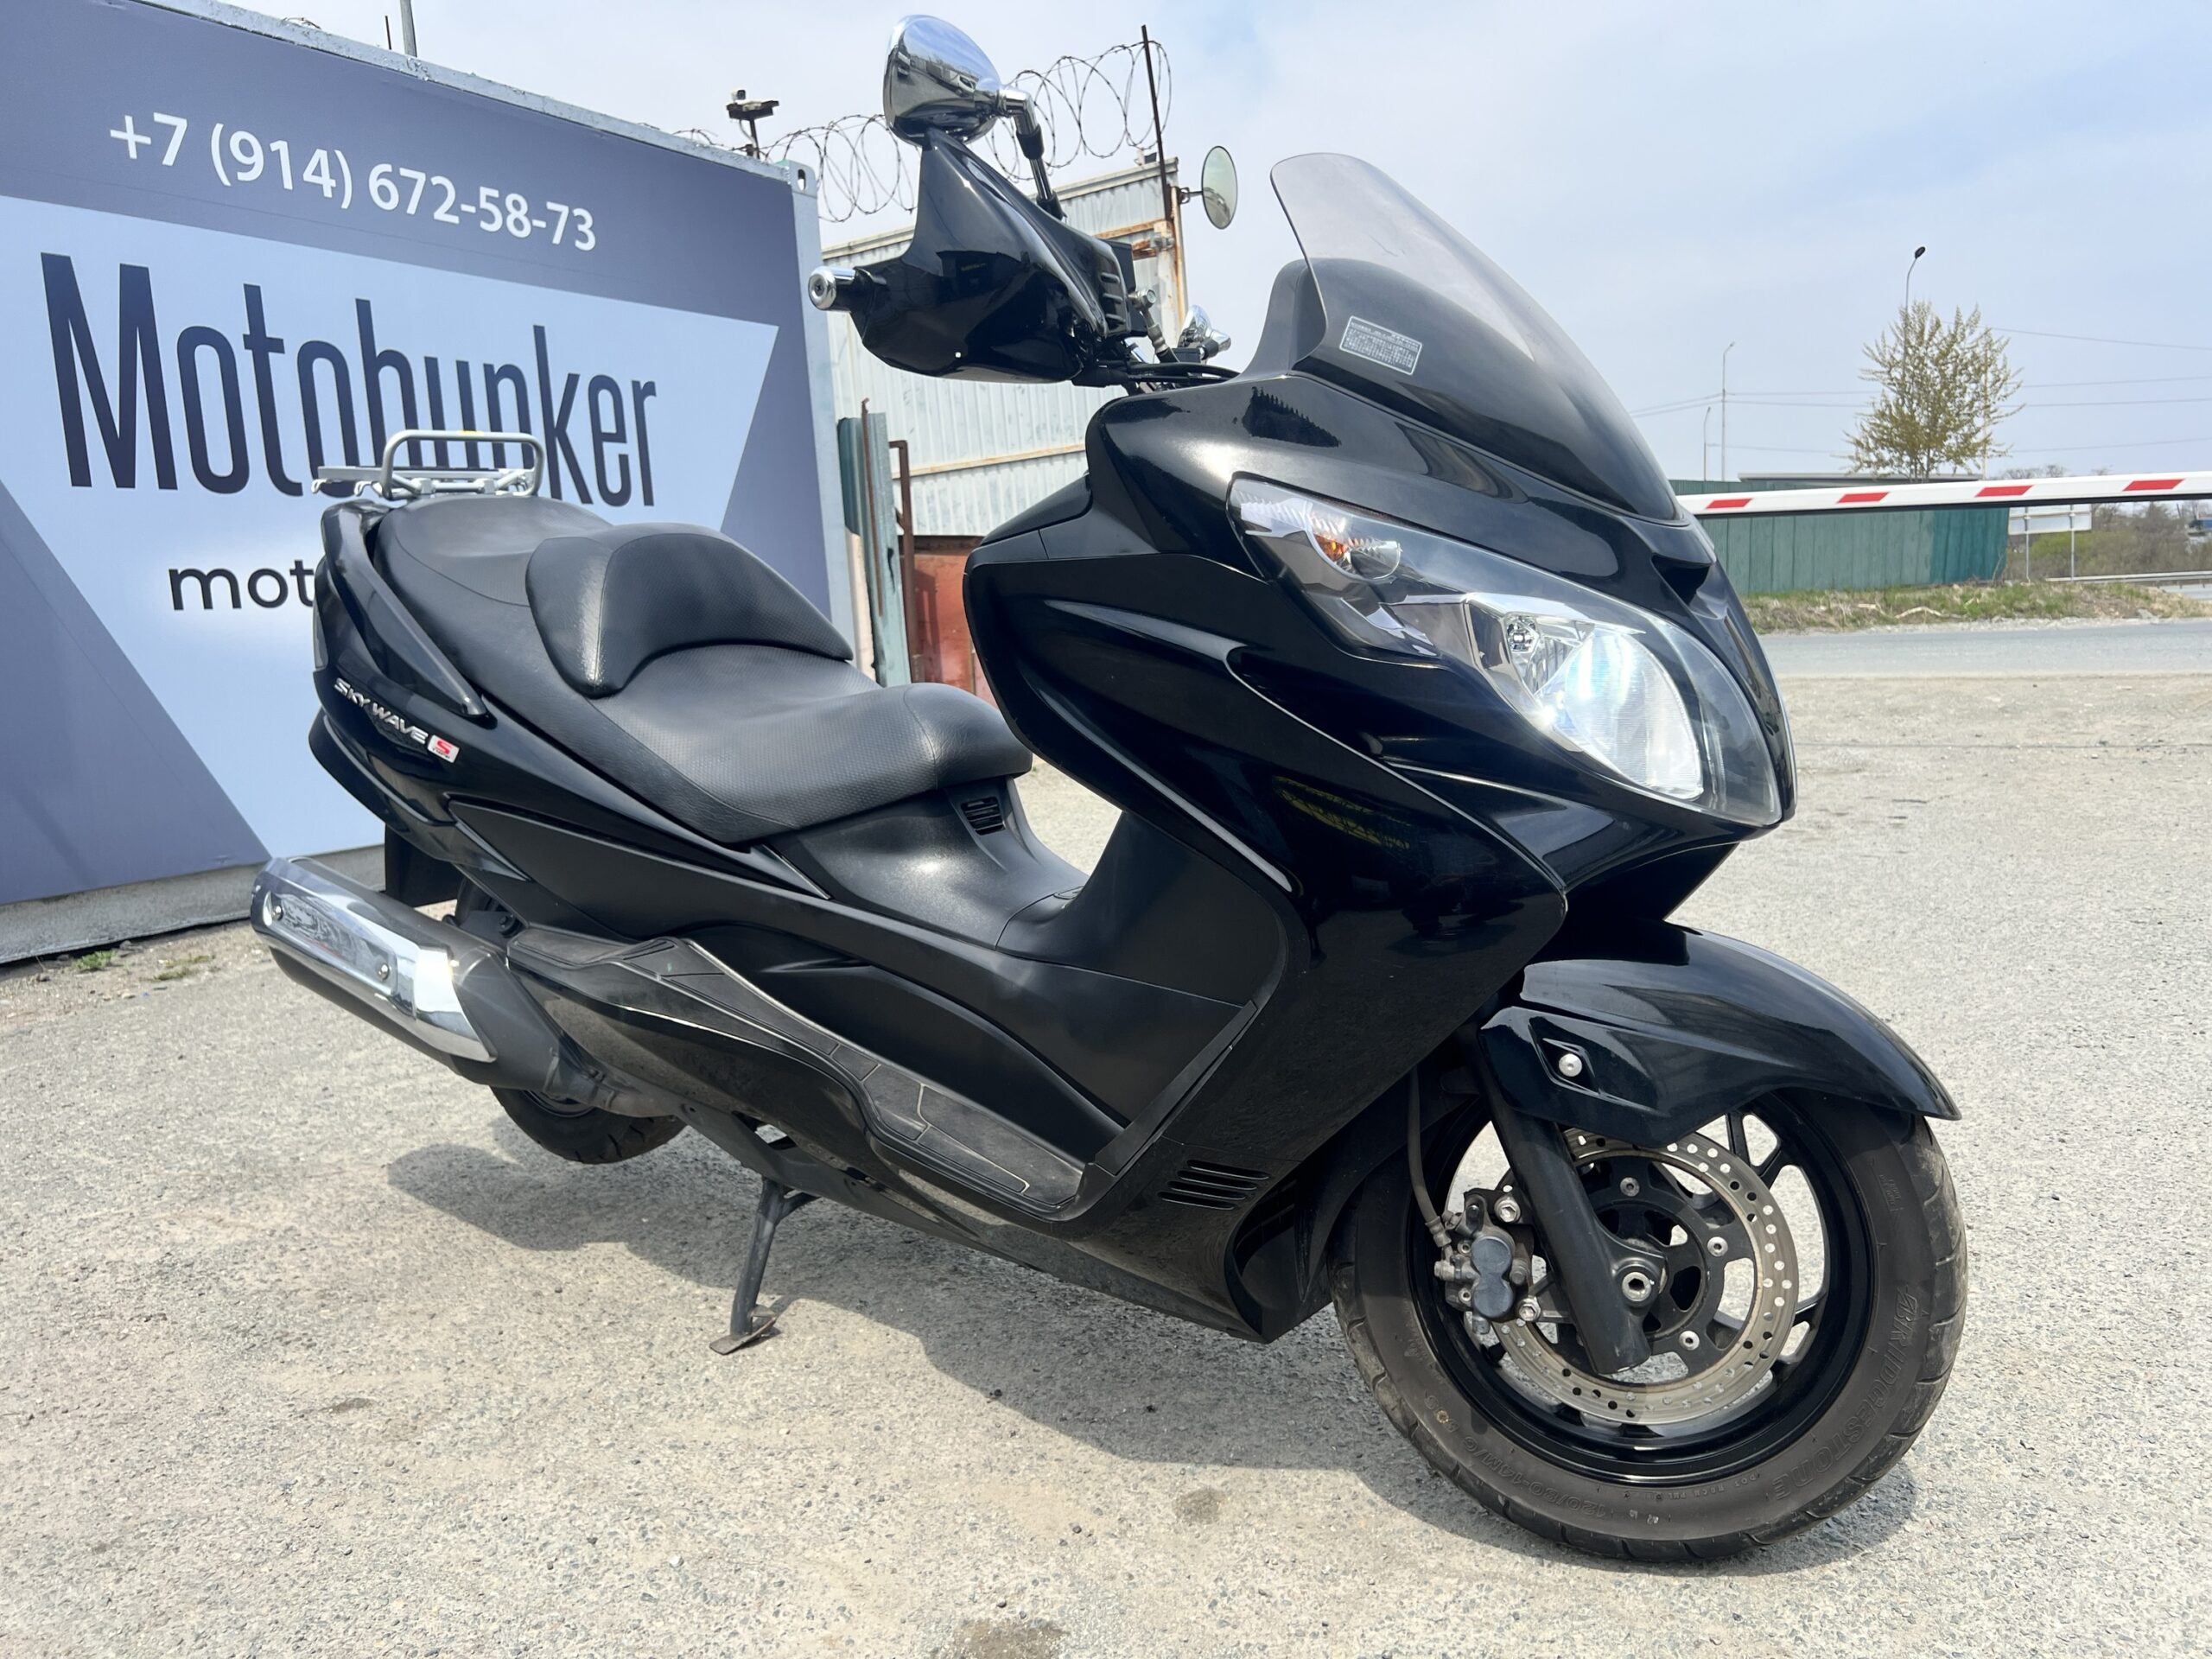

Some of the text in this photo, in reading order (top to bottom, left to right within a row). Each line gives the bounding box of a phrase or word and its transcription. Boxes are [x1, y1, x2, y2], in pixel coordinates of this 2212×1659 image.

[110, 112, 597, 251] +7 (914) 672-58-73
[41, 251, 657, 507] Motobunker
[1771, 1286, 1918, 1500] BRIDGESTONE
